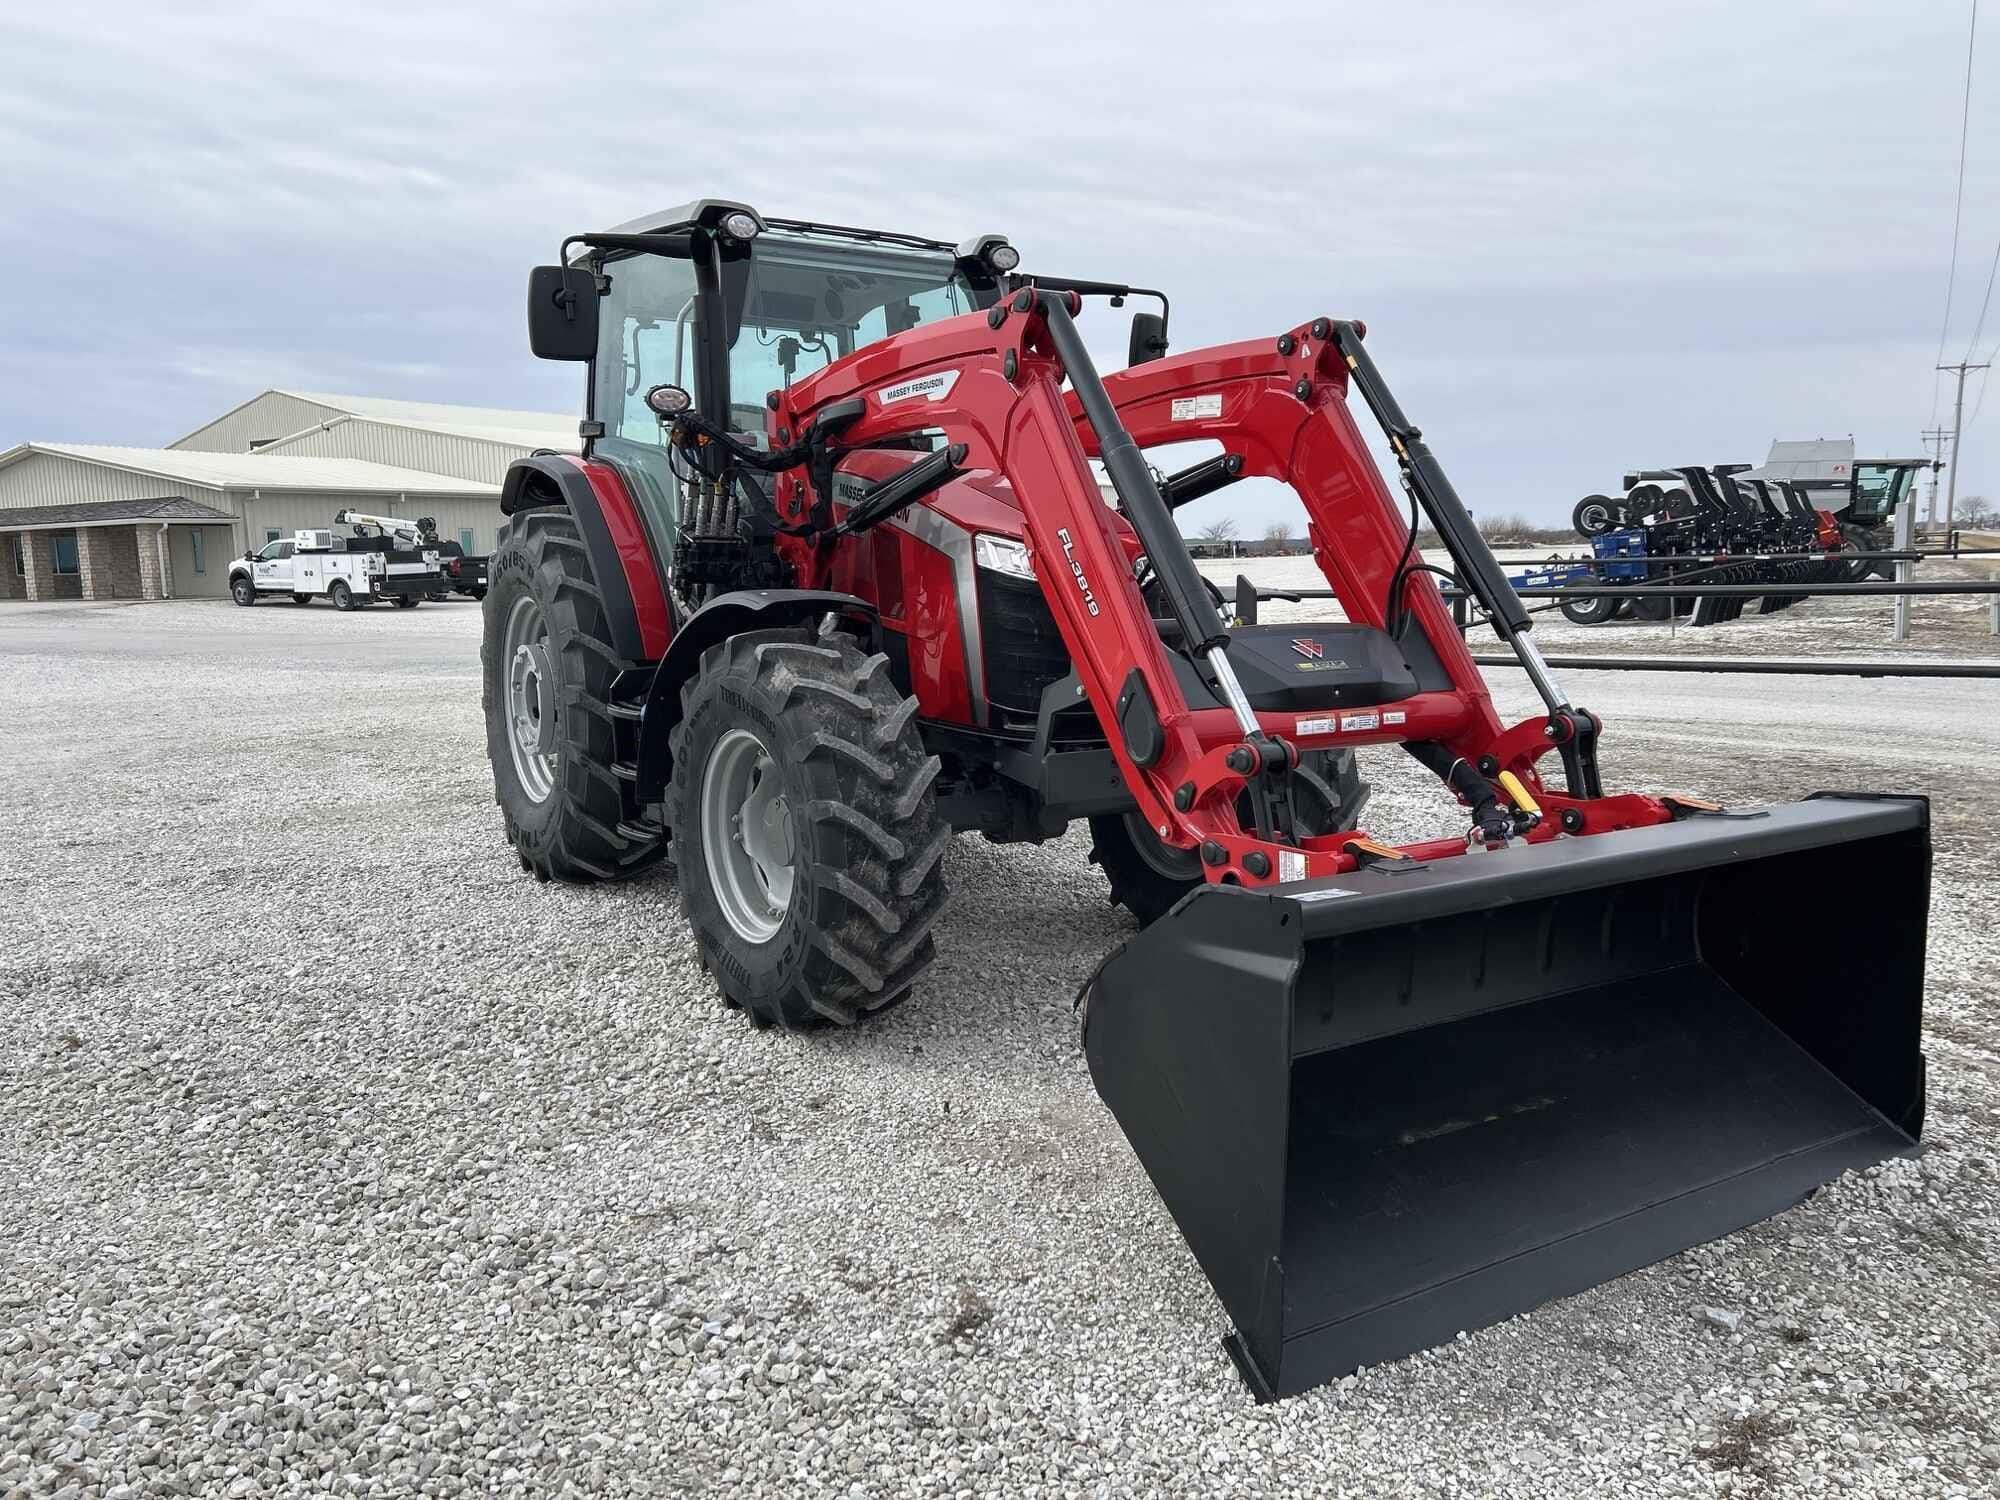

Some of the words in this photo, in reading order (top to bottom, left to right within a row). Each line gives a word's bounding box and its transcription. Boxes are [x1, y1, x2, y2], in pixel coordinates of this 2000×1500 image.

[887, 385, 911, 400] MASSEY
[912, 377, 944, 393] FERGUSON
[839, 483, 867, 502] MASSE
[1057, 528, 1100, 617] FL.3819
